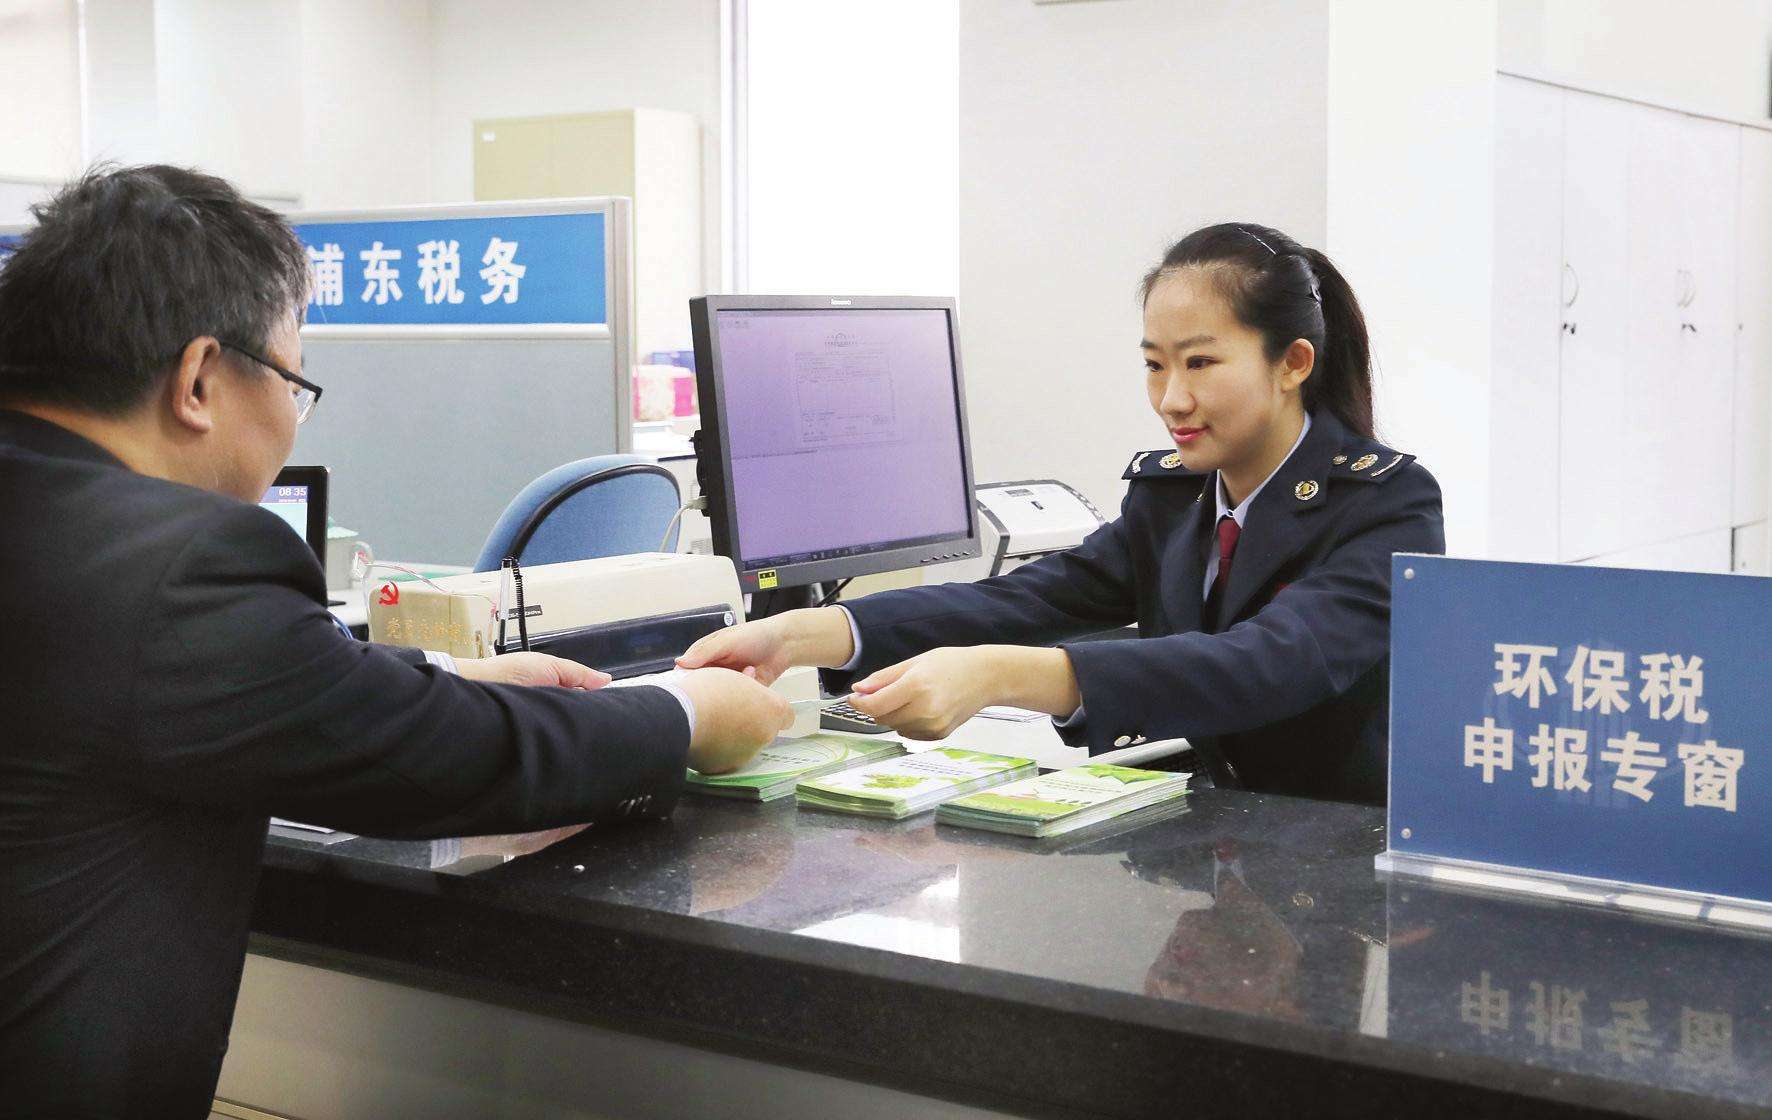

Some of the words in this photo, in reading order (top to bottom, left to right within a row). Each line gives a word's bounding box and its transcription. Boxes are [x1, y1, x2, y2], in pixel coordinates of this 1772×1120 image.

[306, 237, 527, 306] 浦东税务
[1493, 643, 1710, 724] 环保税
[1463, 717, 1745, 812] 申报专窗
